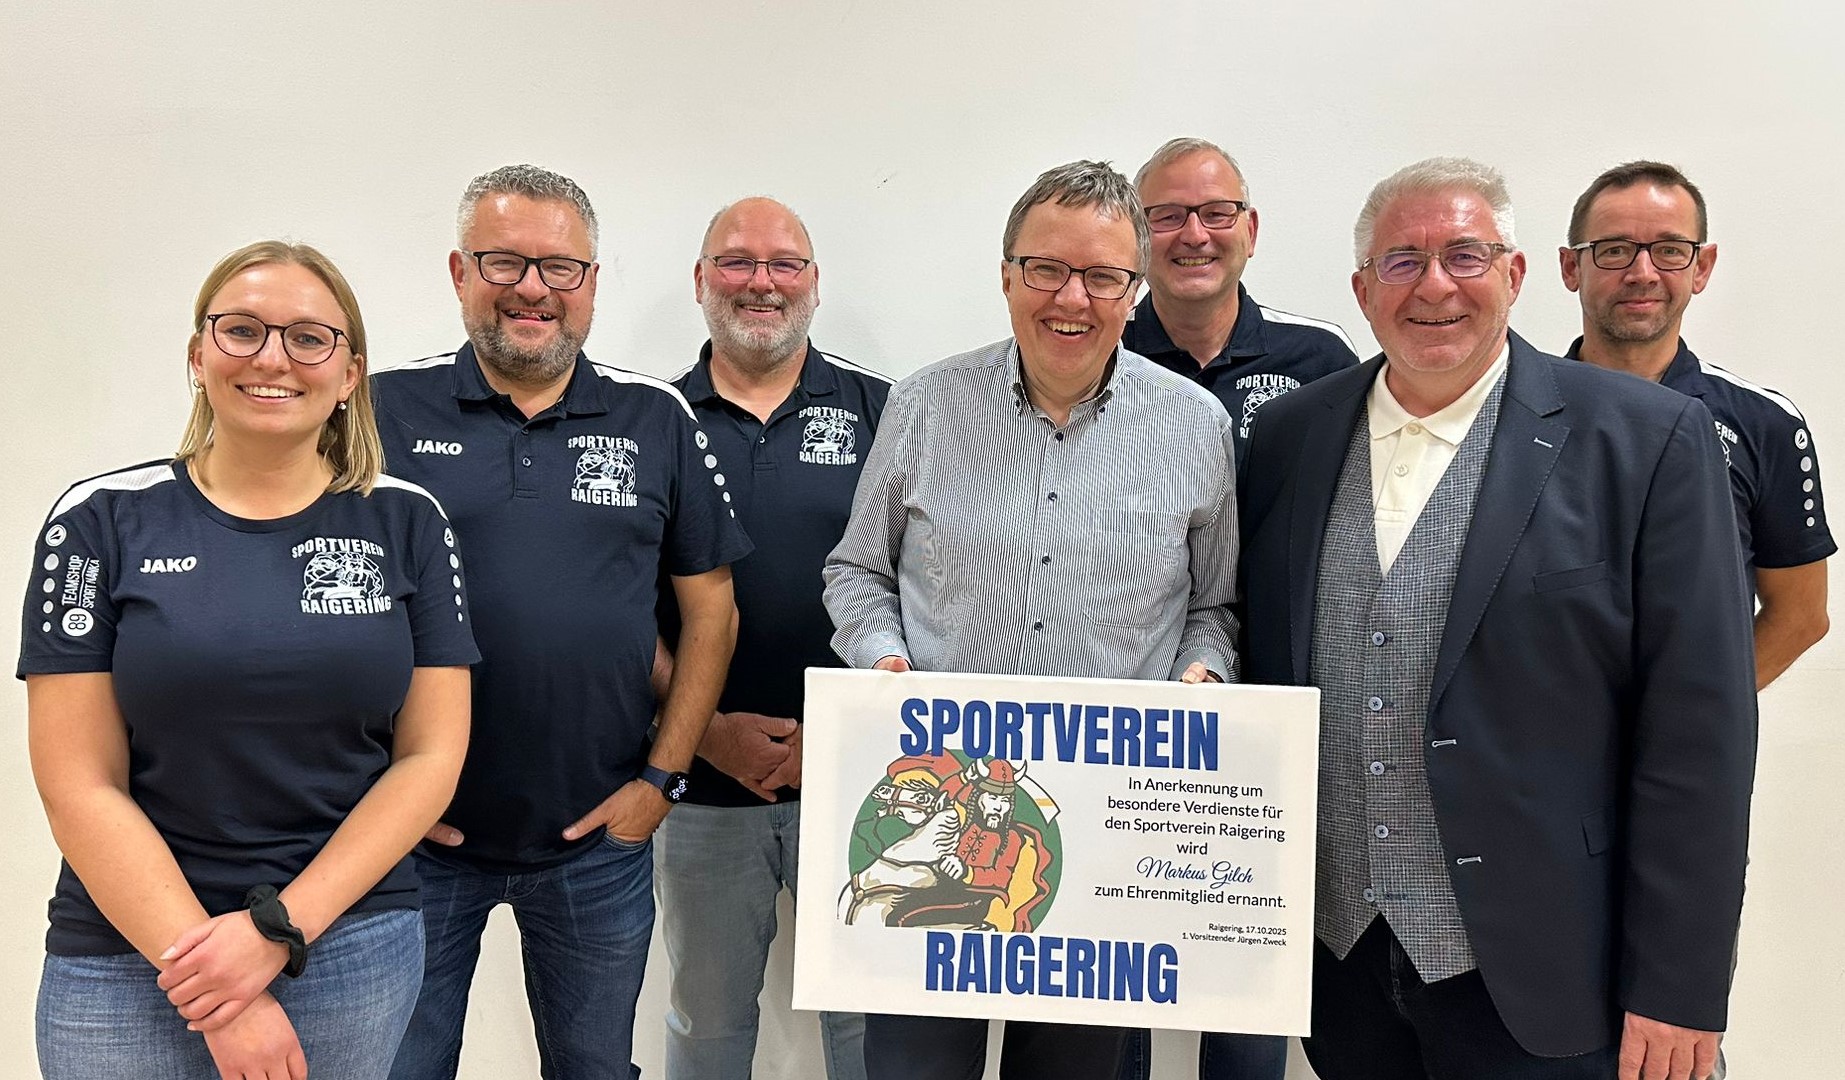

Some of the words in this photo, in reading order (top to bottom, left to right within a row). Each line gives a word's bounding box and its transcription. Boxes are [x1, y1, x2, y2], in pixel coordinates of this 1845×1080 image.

[412, 439, 462, 455] JAKO
[799, 451, 857, 465] RAIGERING
[571, 488, 638, 507] RAIGERING
[292, 537, 384, 558] SPORTVEREIN
[139, 556, 197, 573] JAKO
[62, 555, 84, 606] TEAMSHOP
[82, 584, 97, 609] SPORT
[300, 595, 392, 615] RAIGERING
[68, 613, 87, 630] 89
[900, 698, 1219, 771] SPORTVEREIN
[1128, 777, 1142, 790] In
[1144, 778, 1238, 798] Anerkennung
[1241, 786, 1263, 797] um
[1107, 795, 1181, 811] besondere
[1183, 800, 1260, 818] Verdienste
[1262, 805, 1284, 819] für
[1104, 816, 1131, 830] den
[1133, 818, 1216, 835] Sportverein
[1218, 823, 1286, 842] Raigering
[1176, 842, 1208, 855] wird
[1136, 856, 1208, 880] Markus
[1209, 860, 1254, 890] Gilch
[1094, 885, 1124, 898] zum
[1126, 885, 1225, 905] Ehrenmitglied
[1226, 894, 1287, 909] ernannt.
[1182, 932, 1189, 940] 1.
[1189, 932, 1236, 944] Vorsitzender
[1237, 935, 1262, 946] Jürgen
[1262, 937, 1287, 947] Zweck
[1208, 923, 1245, 934] Raigering,
[1246, 926, 1287, 936] 17.10.2025
[925, 932, 1178, 1004] RAIGERING
